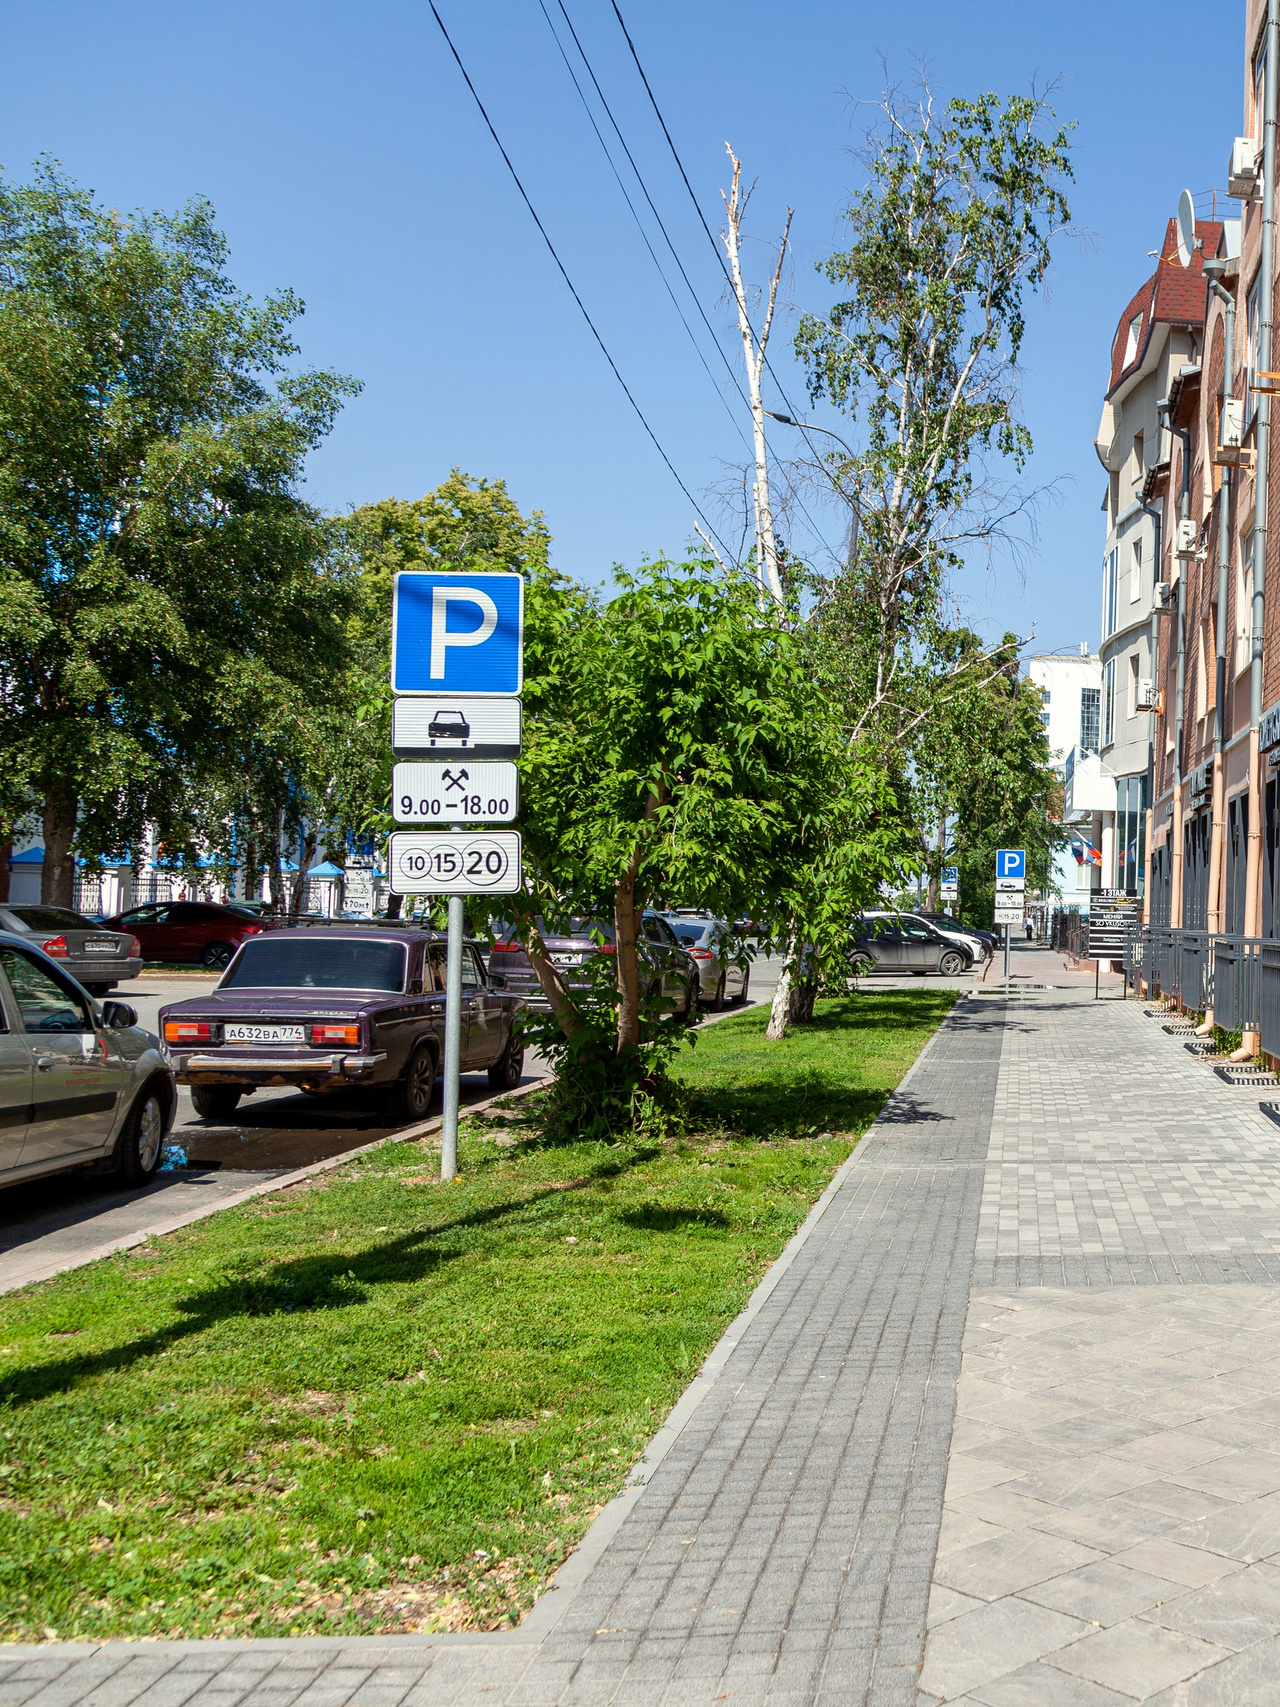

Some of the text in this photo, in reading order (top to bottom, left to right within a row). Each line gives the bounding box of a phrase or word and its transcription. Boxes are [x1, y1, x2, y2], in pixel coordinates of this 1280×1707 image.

[429, 586, 498, 680] P
[407, 850, 502, 875] 10 15 20
[1004, 853, 1020, 875] P
[1108, 889, 1127, 897] ЭТАЖ
[229, 1027, 301, 1039] А632ВА 774
